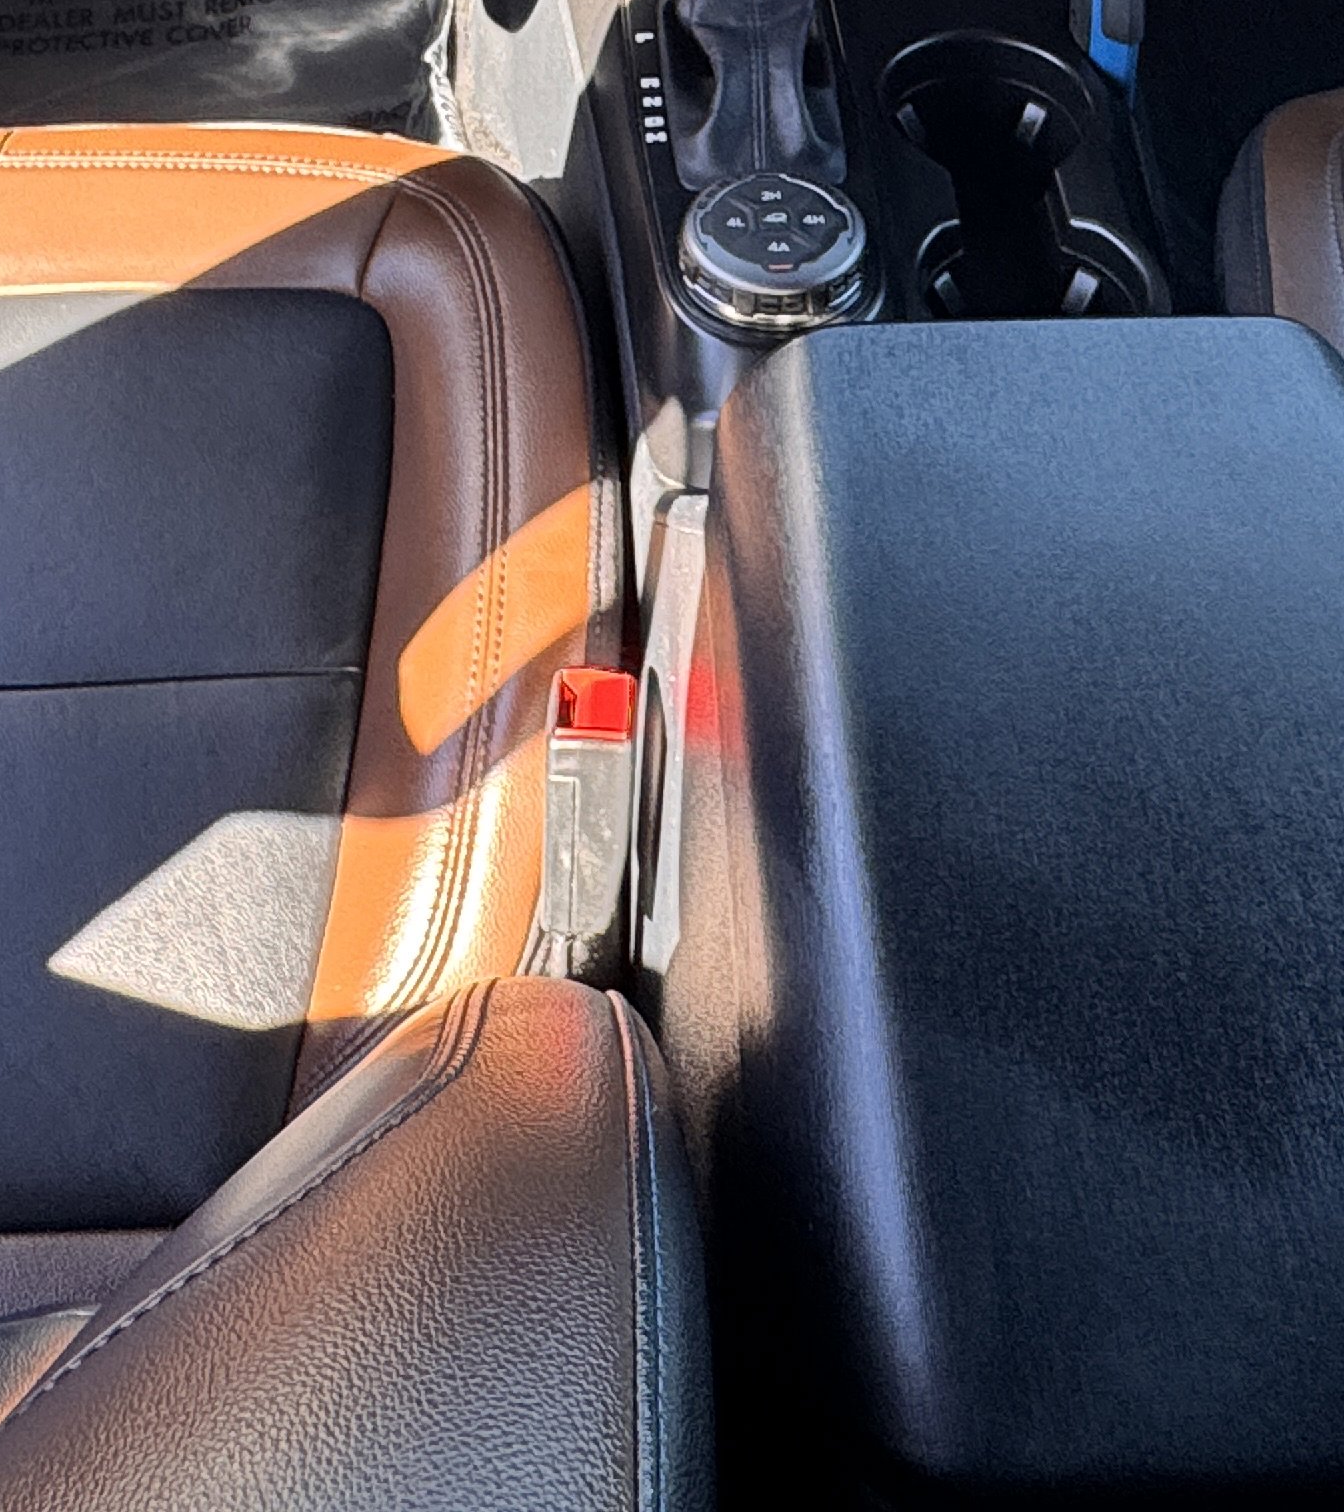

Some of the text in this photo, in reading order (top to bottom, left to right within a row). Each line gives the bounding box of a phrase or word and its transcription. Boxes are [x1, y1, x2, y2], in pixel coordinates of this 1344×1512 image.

[113, 0, 187, 25] MUST
[165, 14, 253, 47] COVER
[726, 216, 746, 228] 4L
[802, 214, 826, 225] 4H
[767, 240, 790, 252] 4A
